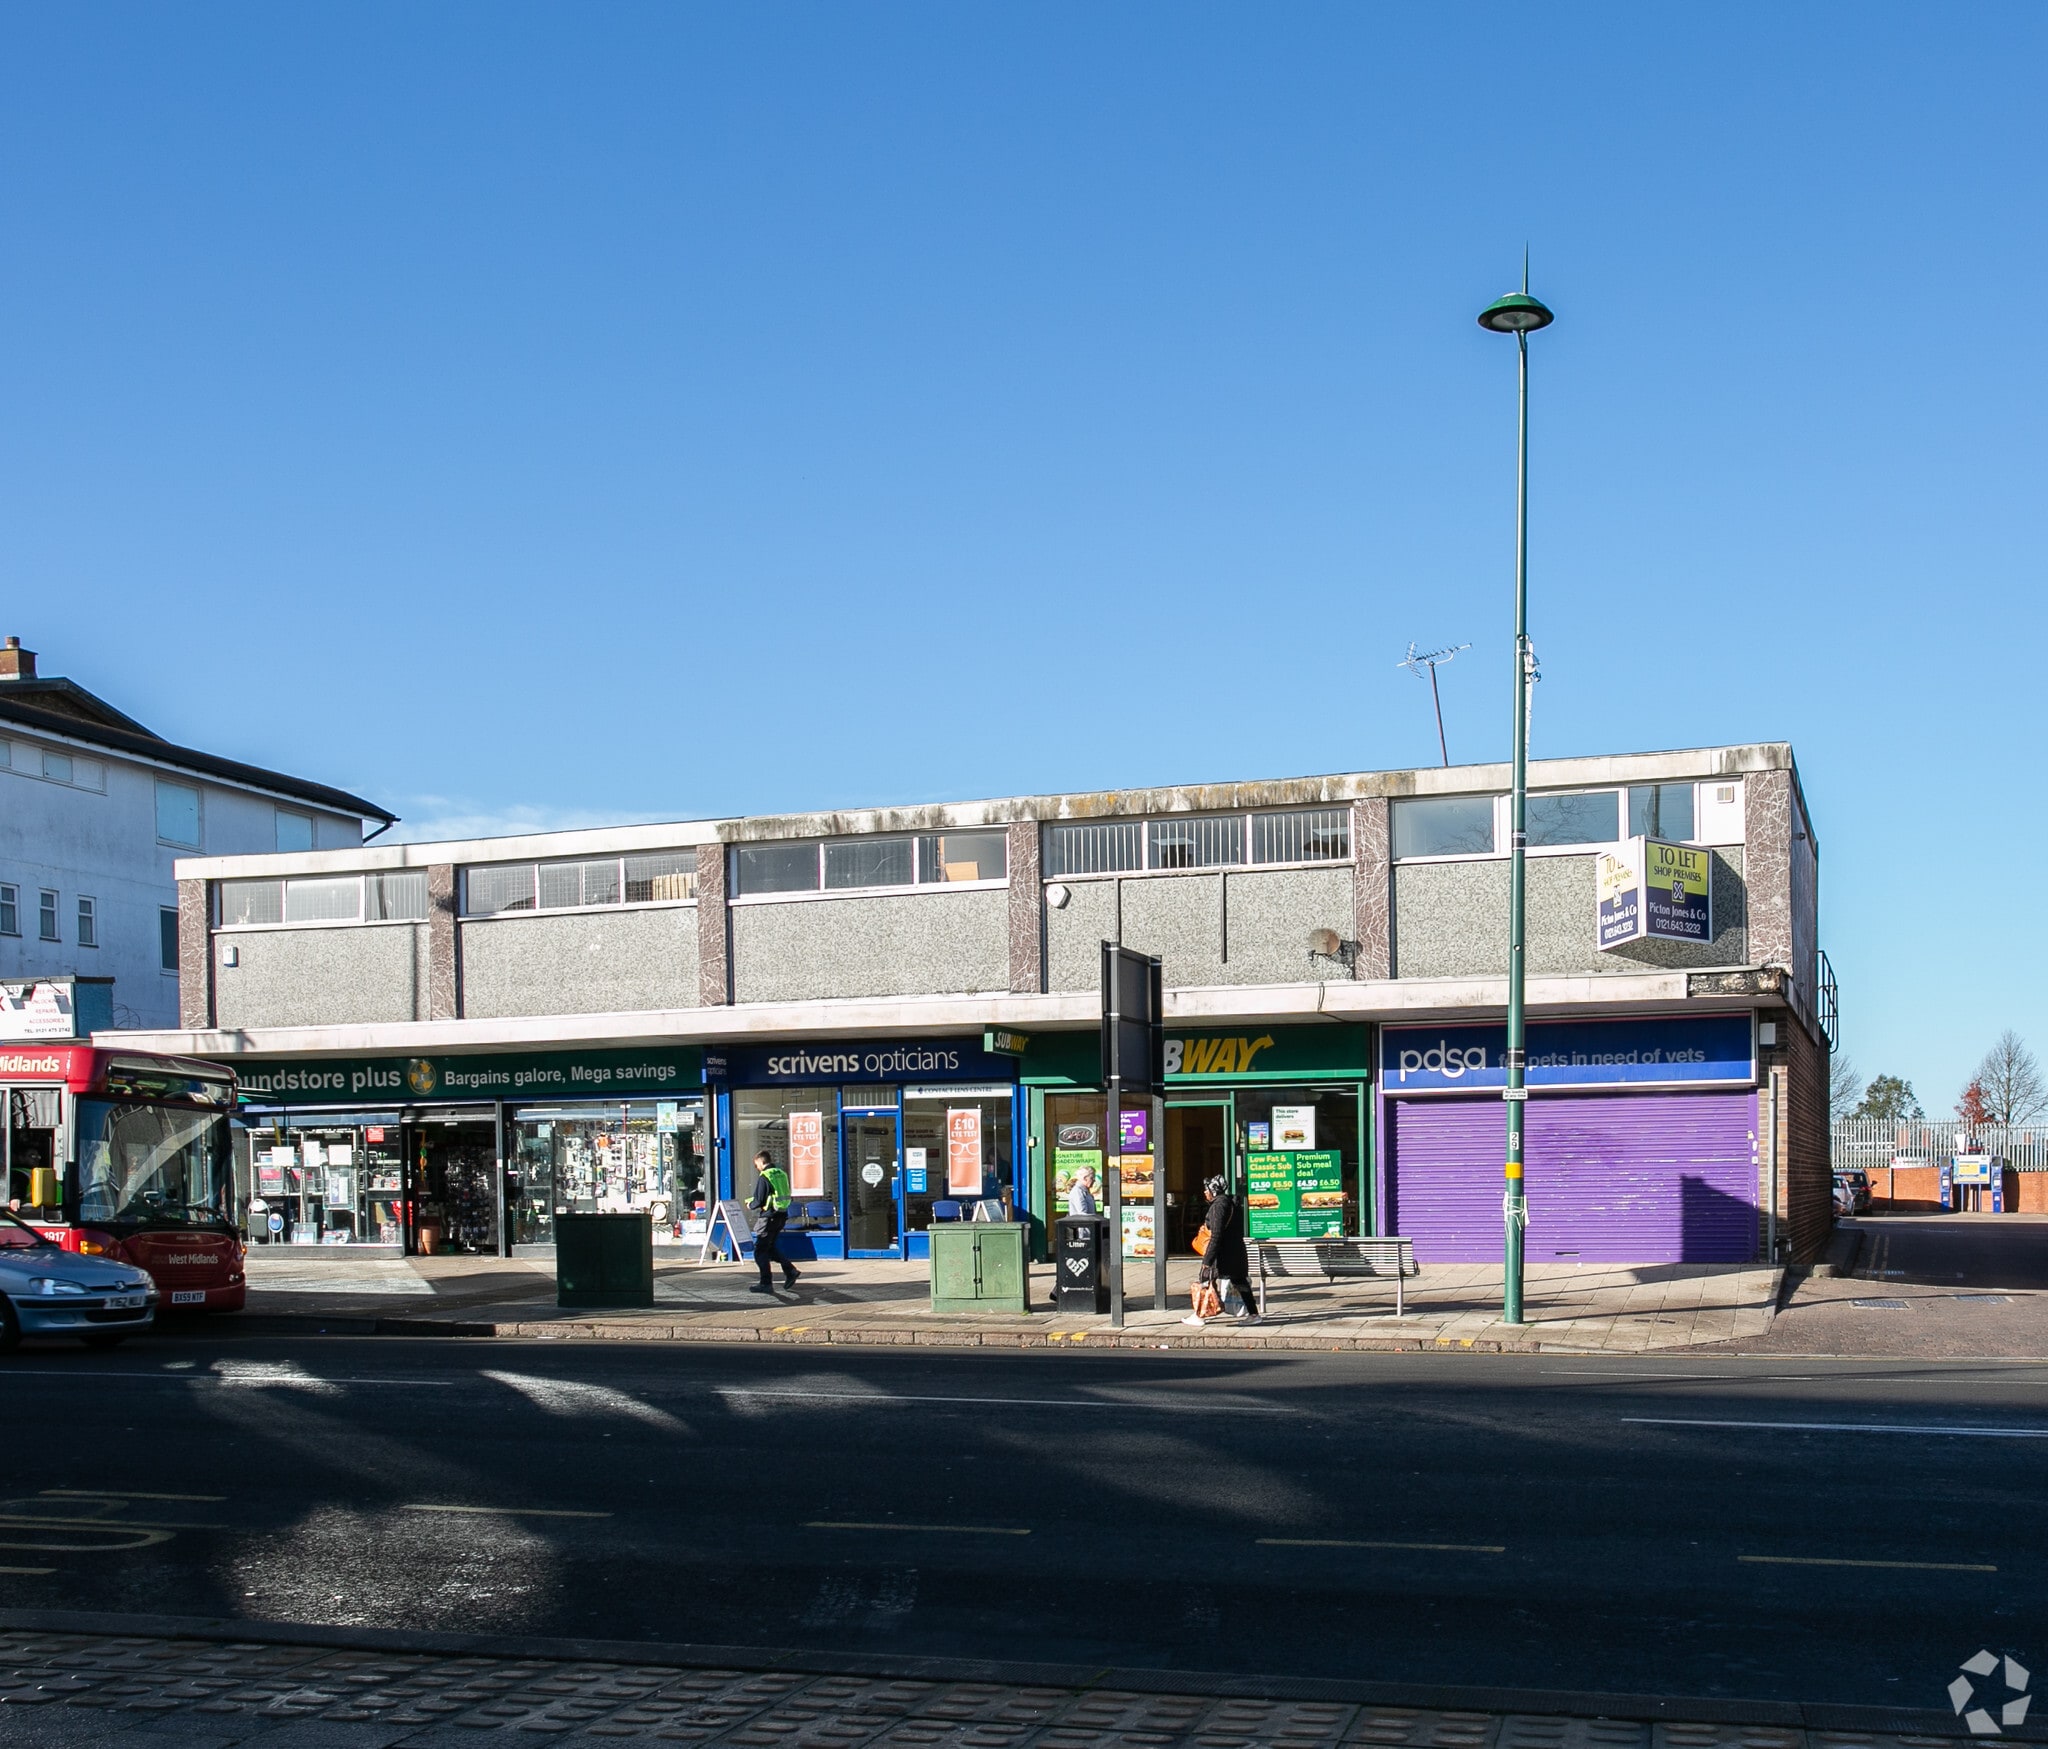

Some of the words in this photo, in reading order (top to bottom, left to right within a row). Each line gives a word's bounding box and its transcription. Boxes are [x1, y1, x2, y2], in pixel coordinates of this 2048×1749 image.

[1658, 847, 1675, 865] TO
[1679, 850, 1697, 869] LET
[1654, 865, 1672, 878] SHOP
[1673, 868, 1701, 882] PREMISES
[1601, 913, 1614, 927] Picton
[1629, 904, 1637, 915] Co
[1649, 902, 1671, 915] Picton
[1671, 905, 1689, 919] Jones
[1690, 908, 1695, 919] &
[1696, 909, 1706, 921] Co
[1655, 918, 1701, 934] 0121.643.3232
[994, 1032, 1029, 1051] SUBWAY
[707, 1056, 727, 1065] scrivens
[768, 1050, 860, 1075] scrivens
[864, 1047, 959, 1077] opticians
[1400, 1040, 1486, 1082] pdsa
[1528, 1054, 1568, 1071] pets
[1572, 1051, 1587, 1066] in
[1591, 1049, 1637, 1065] need
[1641, 1048, 1662, 1064] of
[1665, 1048, 1705, 1063] vets
[352, 1067, 401, 1093] plus
[445, 1069, 510, 1088] Bargains
[514, 1065, 566, 1087] galore,
[571, 1065, 612, 1083] Mega
[615, 1063, 677, 1081] savings
[796, 1121, 816, 1133] £10
[954, 1118, 975, 1130] £10
[1296, 1153, 1331, 1161] Premium
[1250, 1181, 1271, 1189] £3.50
[1138, 1215, 1153, 1223] 99p
[44, 1231, 66, 1242] 1917
[169, 1254, 187, 1264] West
[189, 1253, 219, 1264] Midlands
[174, 1293, 191, 1302] BX59
